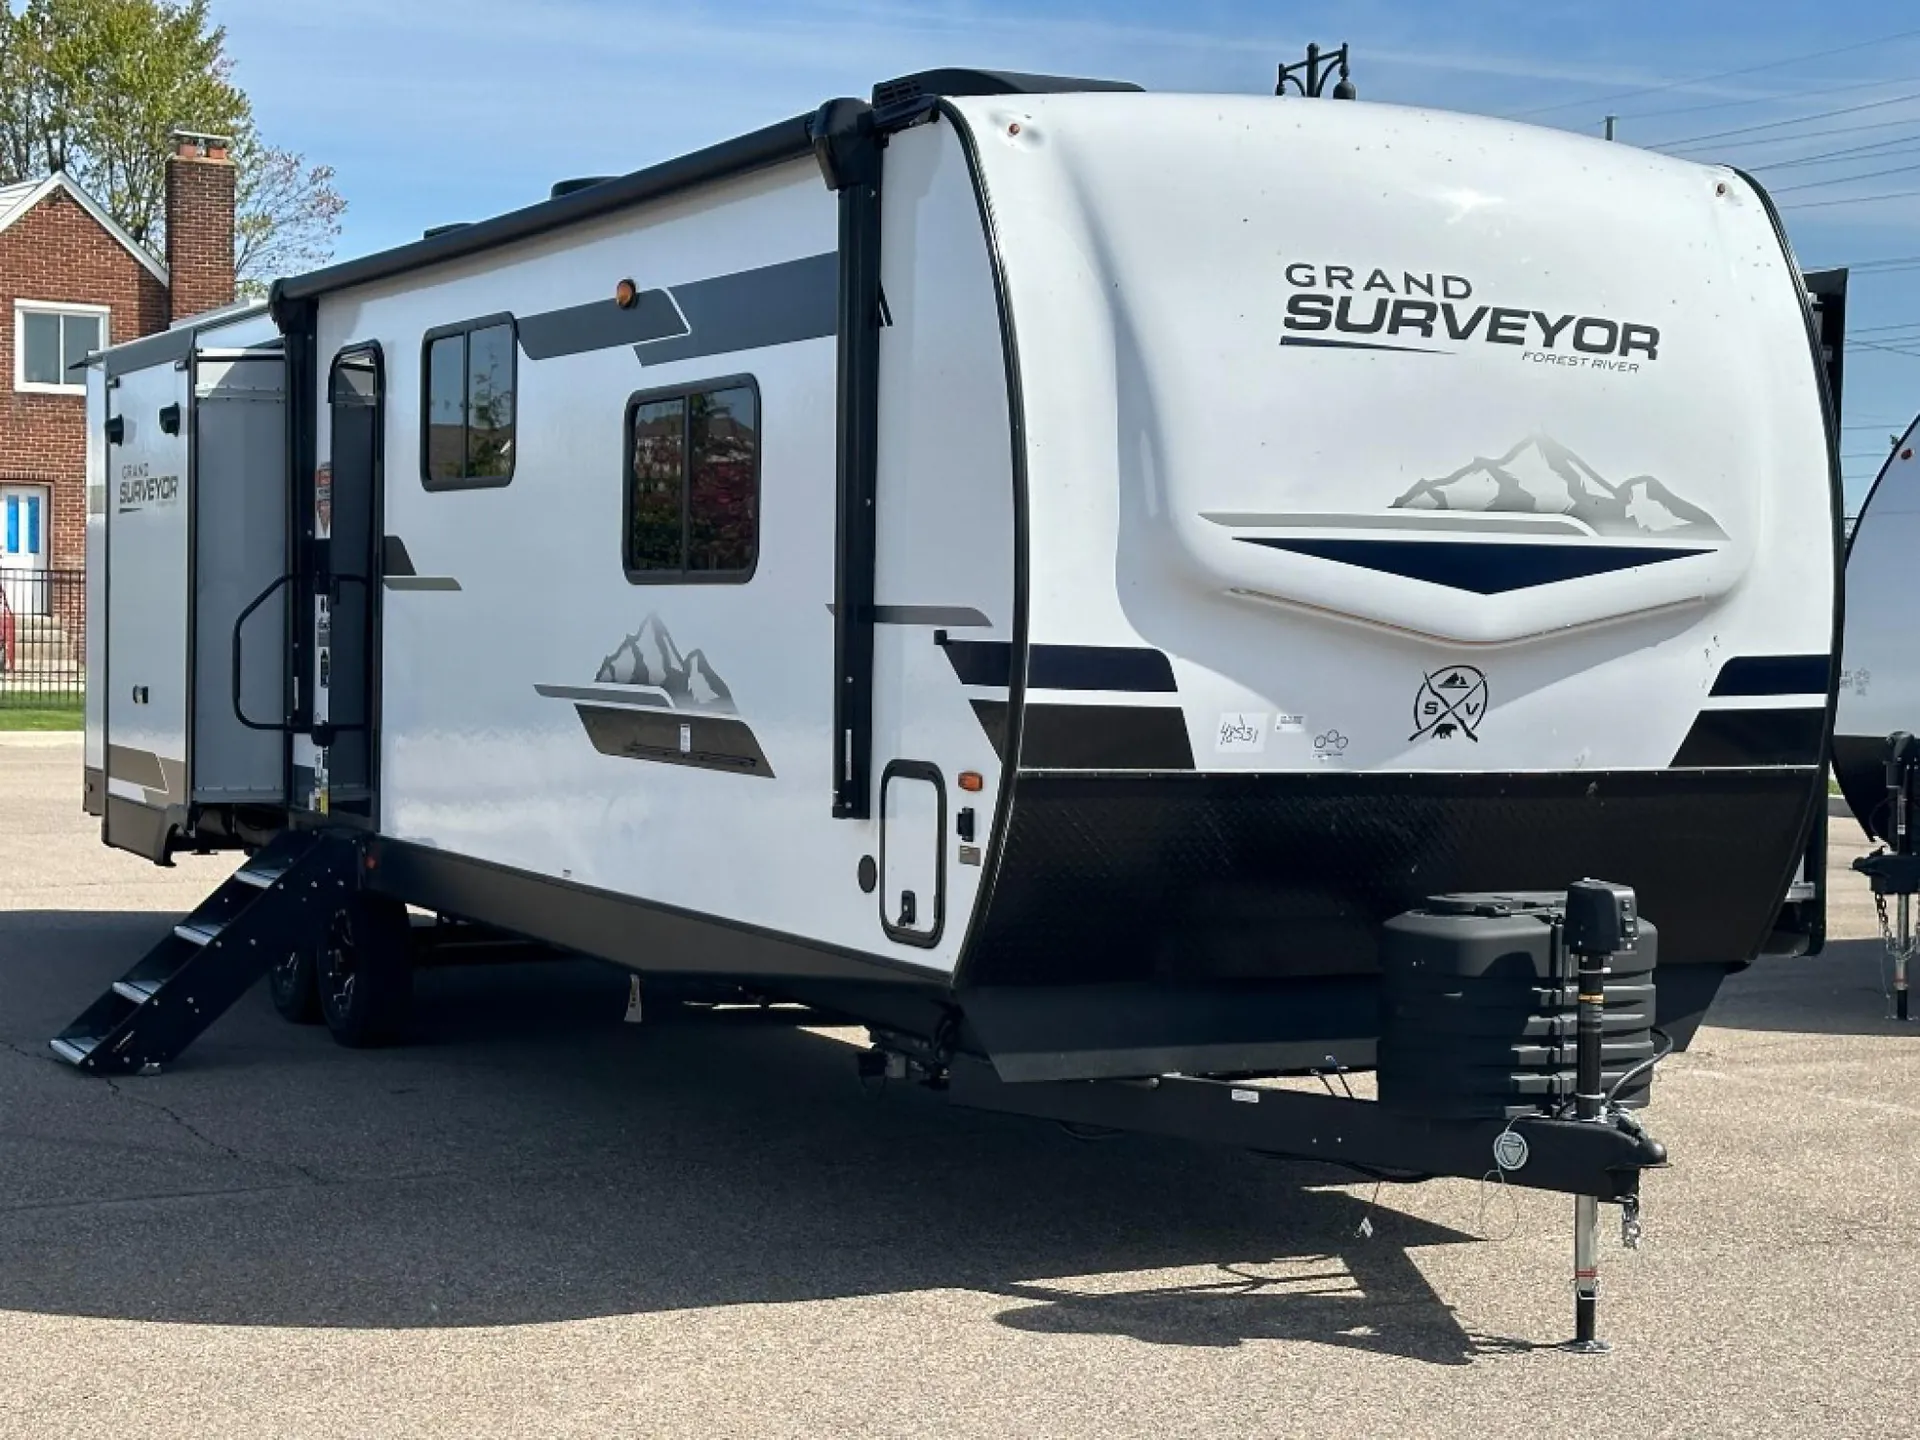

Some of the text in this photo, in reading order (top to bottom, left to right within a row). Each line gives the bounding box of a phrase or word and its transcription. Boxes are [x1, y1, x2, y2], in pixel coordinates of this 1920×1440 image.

[1285, 262, 1473, 300] GRAND
[1283, 294, 1661, 361] SURVEYOR
[1521, 350, 1640, 374] FOREST RIVER
[119, 475, 179, 504] SURVEYOR
[1423, 701, 1480, 715] S V
